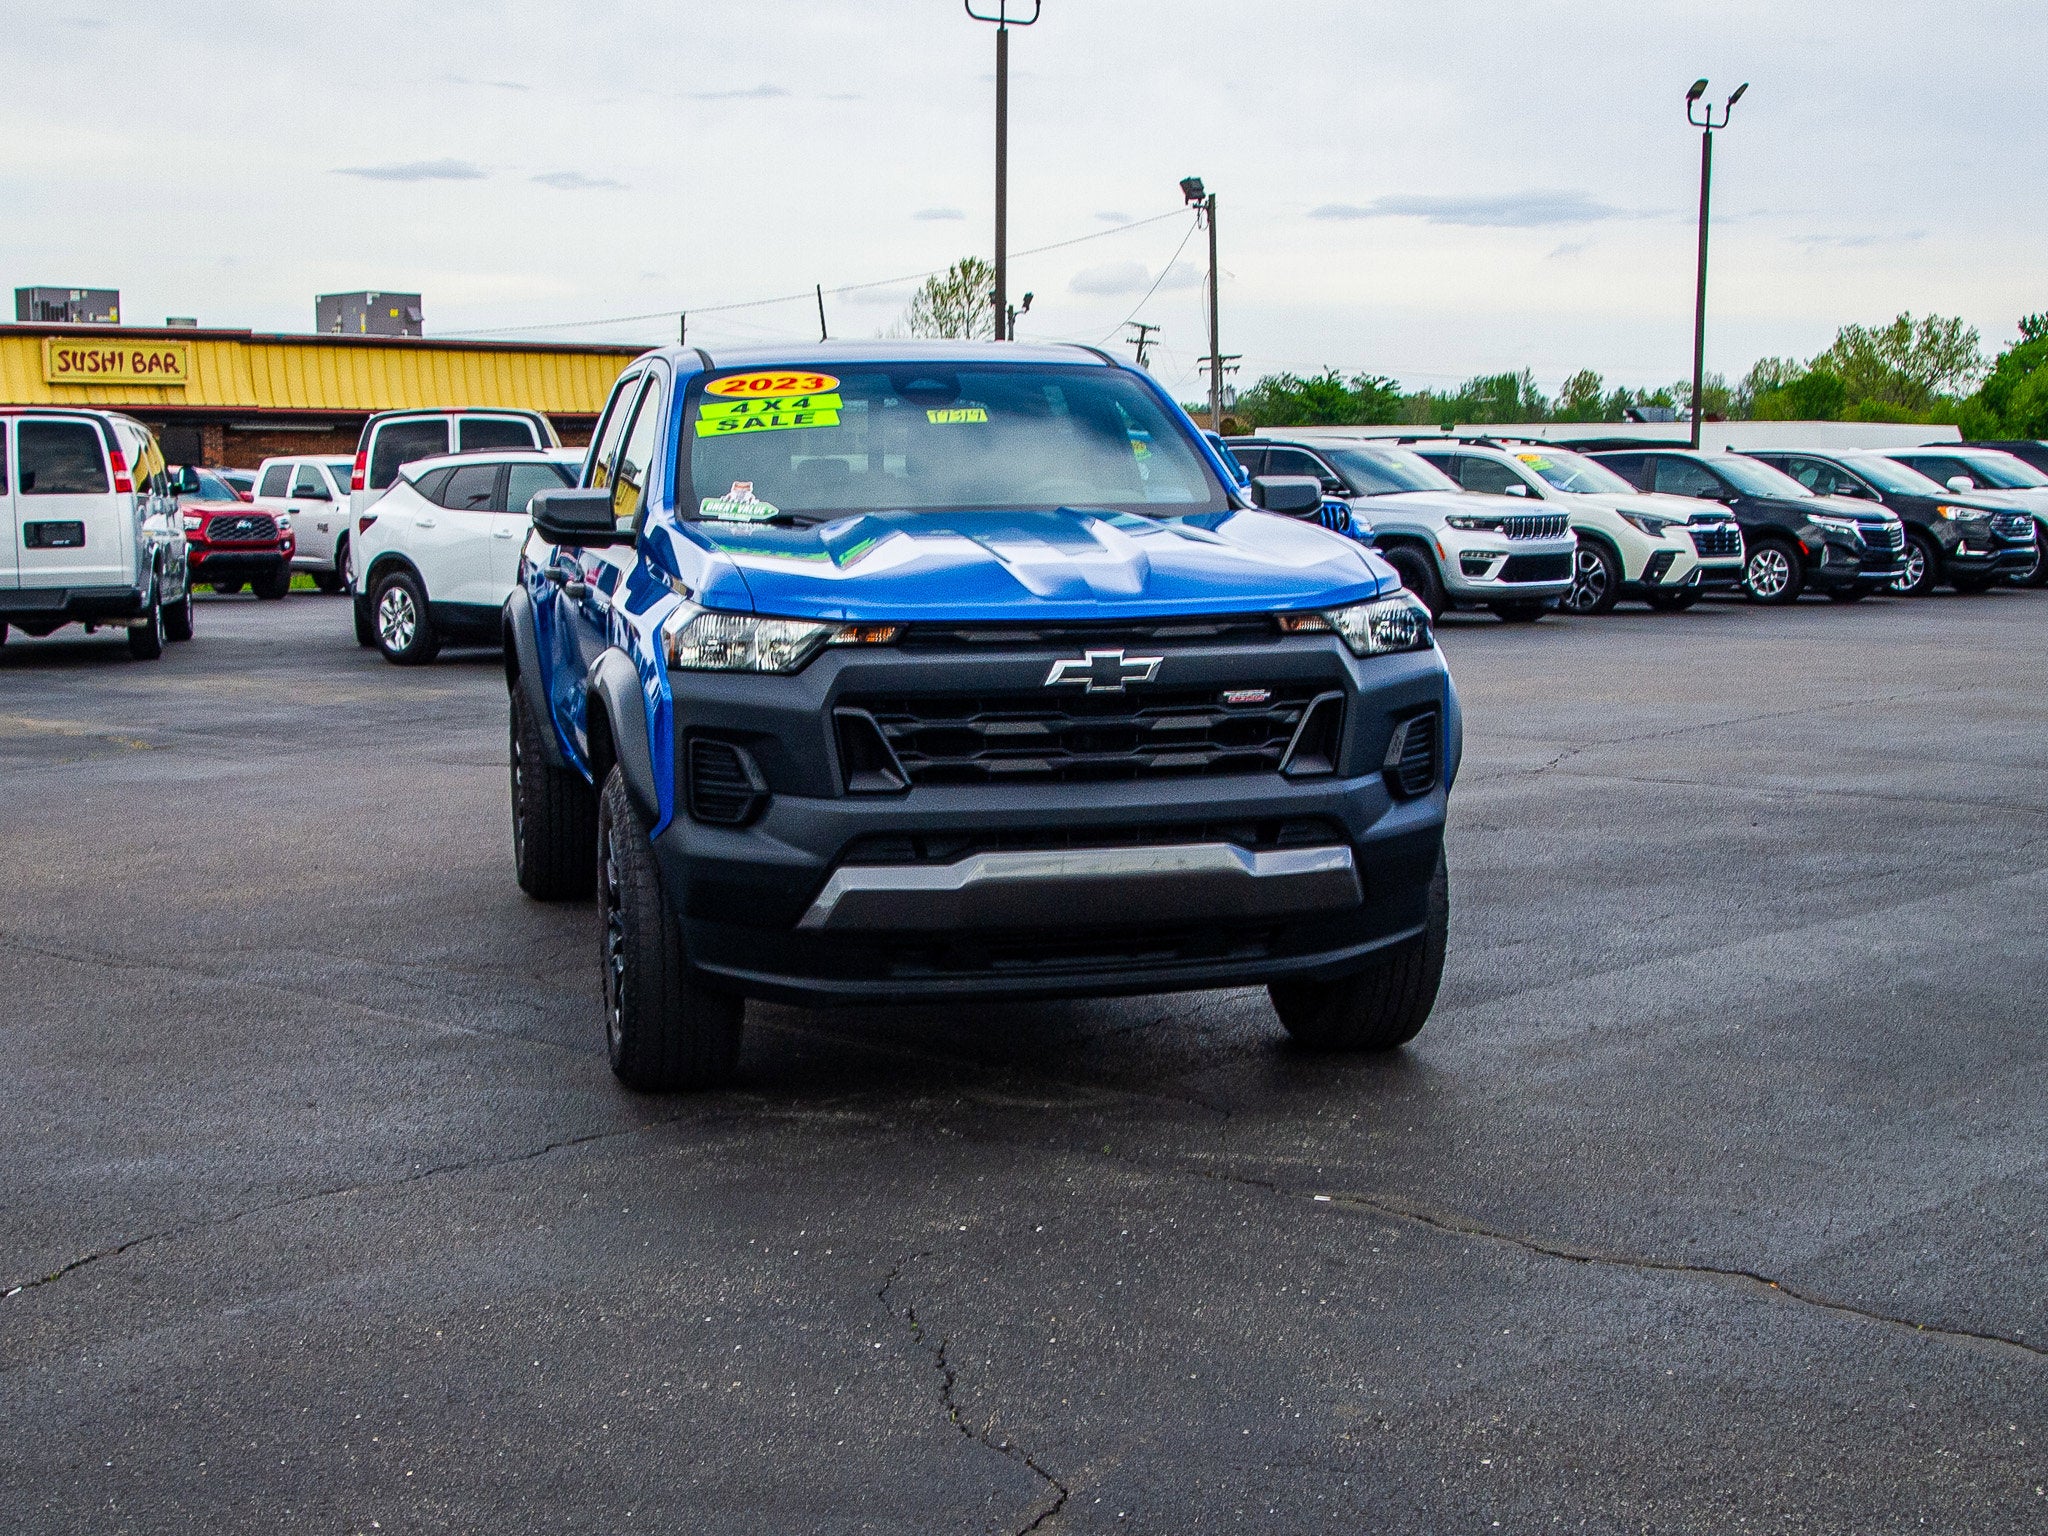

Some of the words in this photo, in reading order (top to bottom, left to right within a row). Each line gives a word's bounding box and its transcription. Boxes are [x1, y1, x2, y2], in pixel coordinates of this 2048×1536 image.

[57, 350, 123, 372] SUSHI
[132, 351, 180, 374] BAR
[721, 377, 824, 394] 2023
[717, 412, 815, 430] SALE
